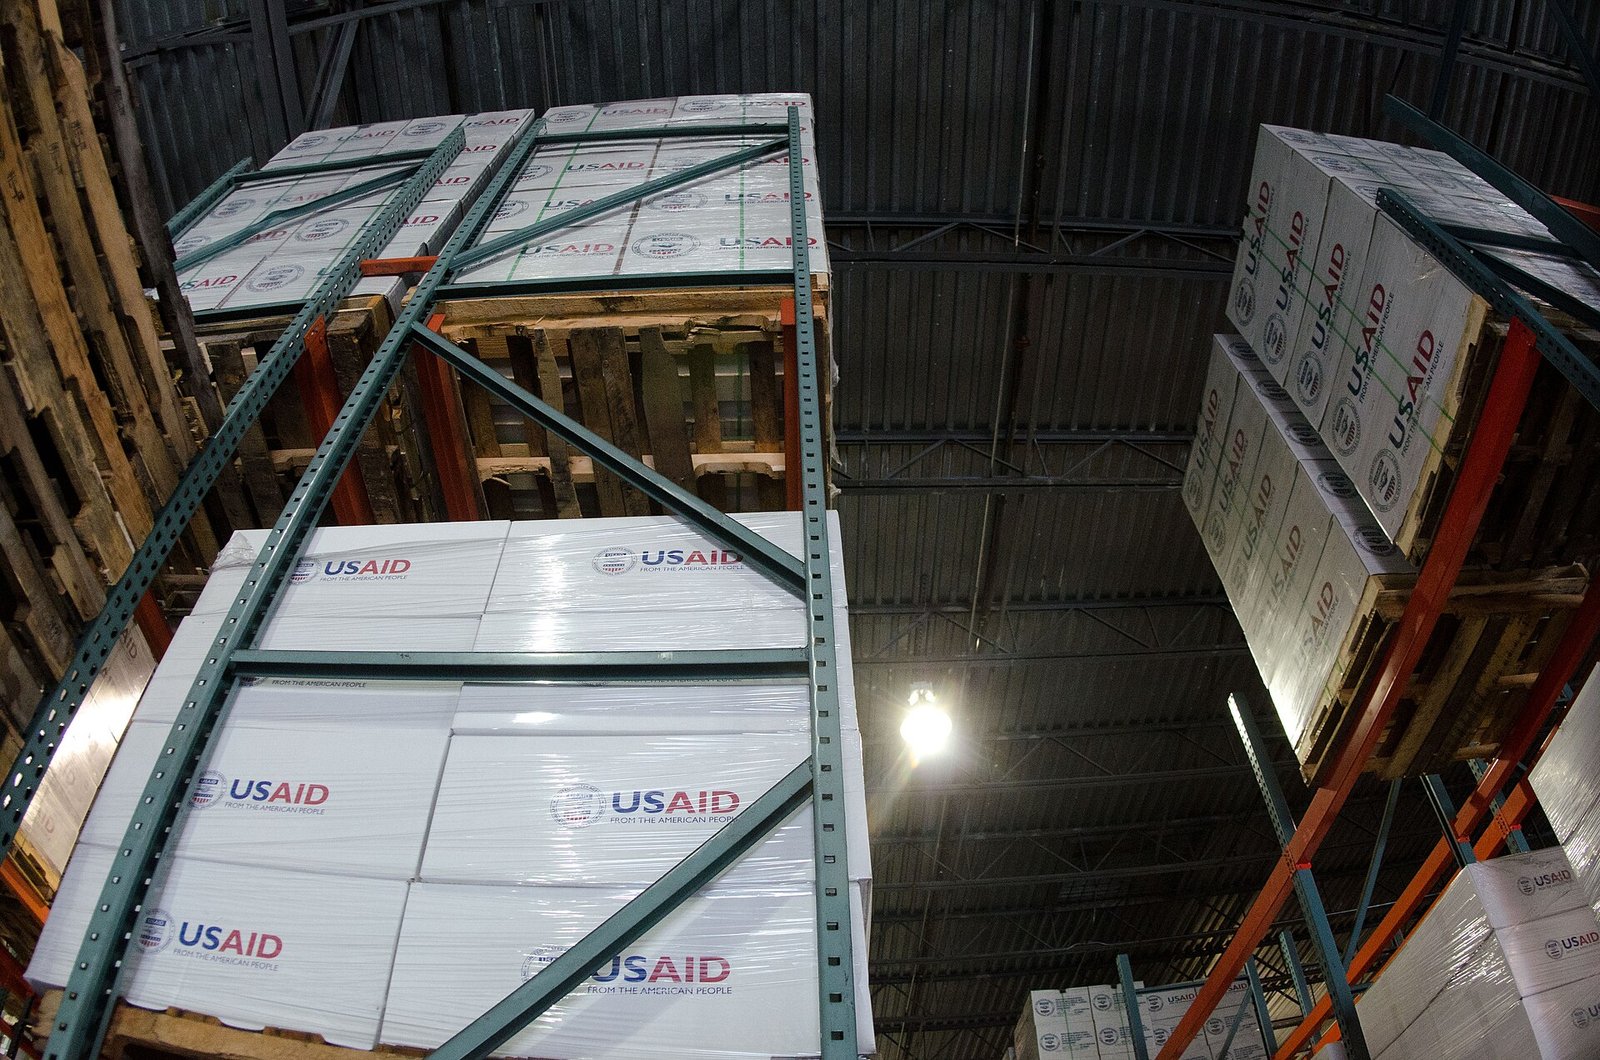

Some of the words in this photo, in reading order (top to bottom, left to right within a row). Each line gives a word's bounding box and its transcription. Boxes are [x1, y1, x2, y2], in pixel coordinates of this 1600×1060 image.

[463, 144, 498, 153] AID
[567, 161, 645, 171] USAID
[434, 176, 471, 186] AID
[400, 215, 440, 225] AID
[1246, 181, 1270, 275] USAID
[521, 243, 614, 255] USAID
[1276, 211, 1304, 310] USAID
[1312, 243, 1344, 349] USAID
[1382, 292, 1395, 326] PEOPLE
[1347, 283, 1385, 396] USAID
[1431, 340, 1445, 376] PEOPLE
[1388, 329, 1435, 449] USAID
[324, 559, 412, 576] USAID
[642, 550, 744, 566] USAID
[120, 627, 138, 660] AID
[230, 779, 330, 805] USAID
[612, 791, 740, 814] USAID
[224, 801, 245, 809] FROM
[246, 803, 259, 811] THE
[259, 804, 298, 814] AMERICAN
[298, 807, 326, 816] PEOPLE
[610, 816, 636, 825] FROM
[638, 816, 656, 825] THE
[657, 816, 706, 824] AMERICAN
[1534, 869, 1572, 887] USAID
[179, 922, 283, 959] USAID
[1561, 931, 1600, 950] USAID
[174, 948, 194, 958] FROM
[195, 951, 210, 961] THE
[210, 954, 250, 967] AMERICAN
[250, 960, 280, 972] PEOPLE
[591, 955, 731, 983] USAID
[587, 986, 615, 995] FROM
[619, 986, 638, 995] THE
[640, 986, 694, 995] AMERICAN
[695, 986, 733, 995] PEOPLE
